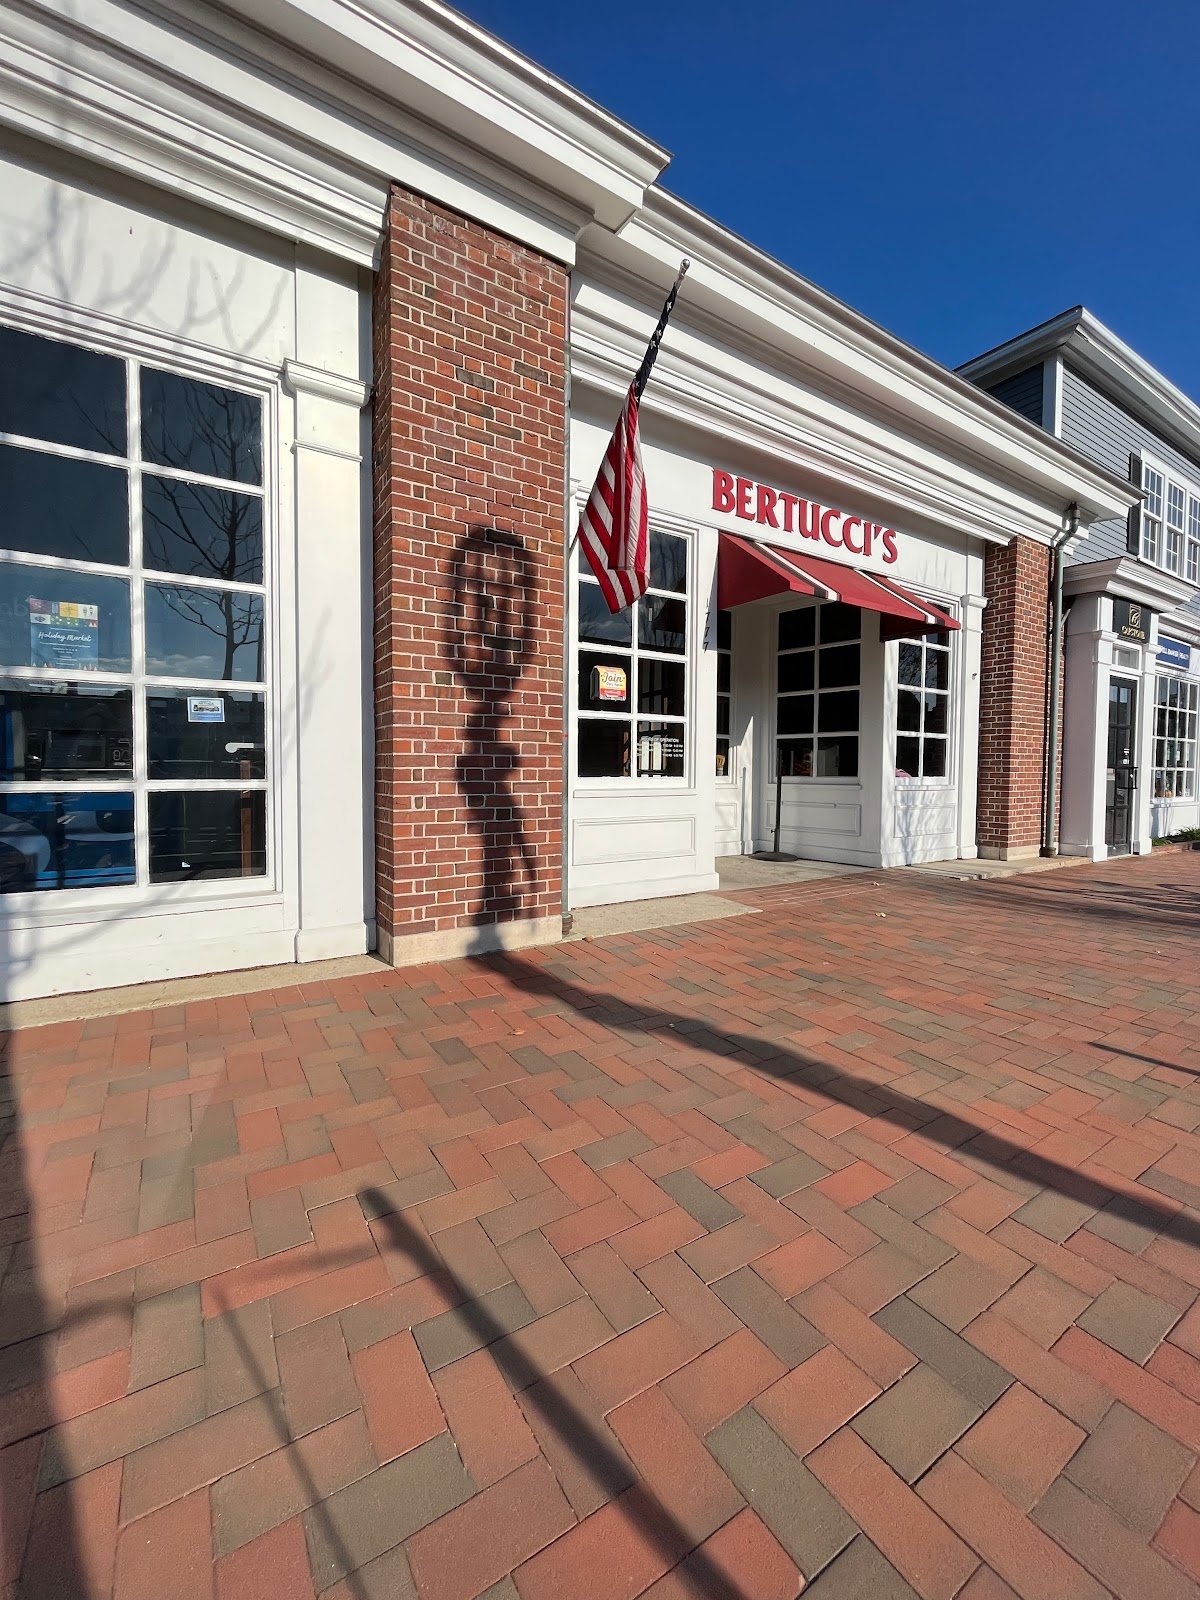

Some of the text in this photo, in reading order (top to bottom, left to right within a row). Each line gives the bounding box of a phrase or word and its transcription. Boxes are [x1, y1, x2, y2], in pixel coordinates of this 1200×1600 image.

[712, 468, 898, 565] BERTUCCI'S
[38, 631, 92, 642] Holiday Market
[602, 671, 624, 683] Join
